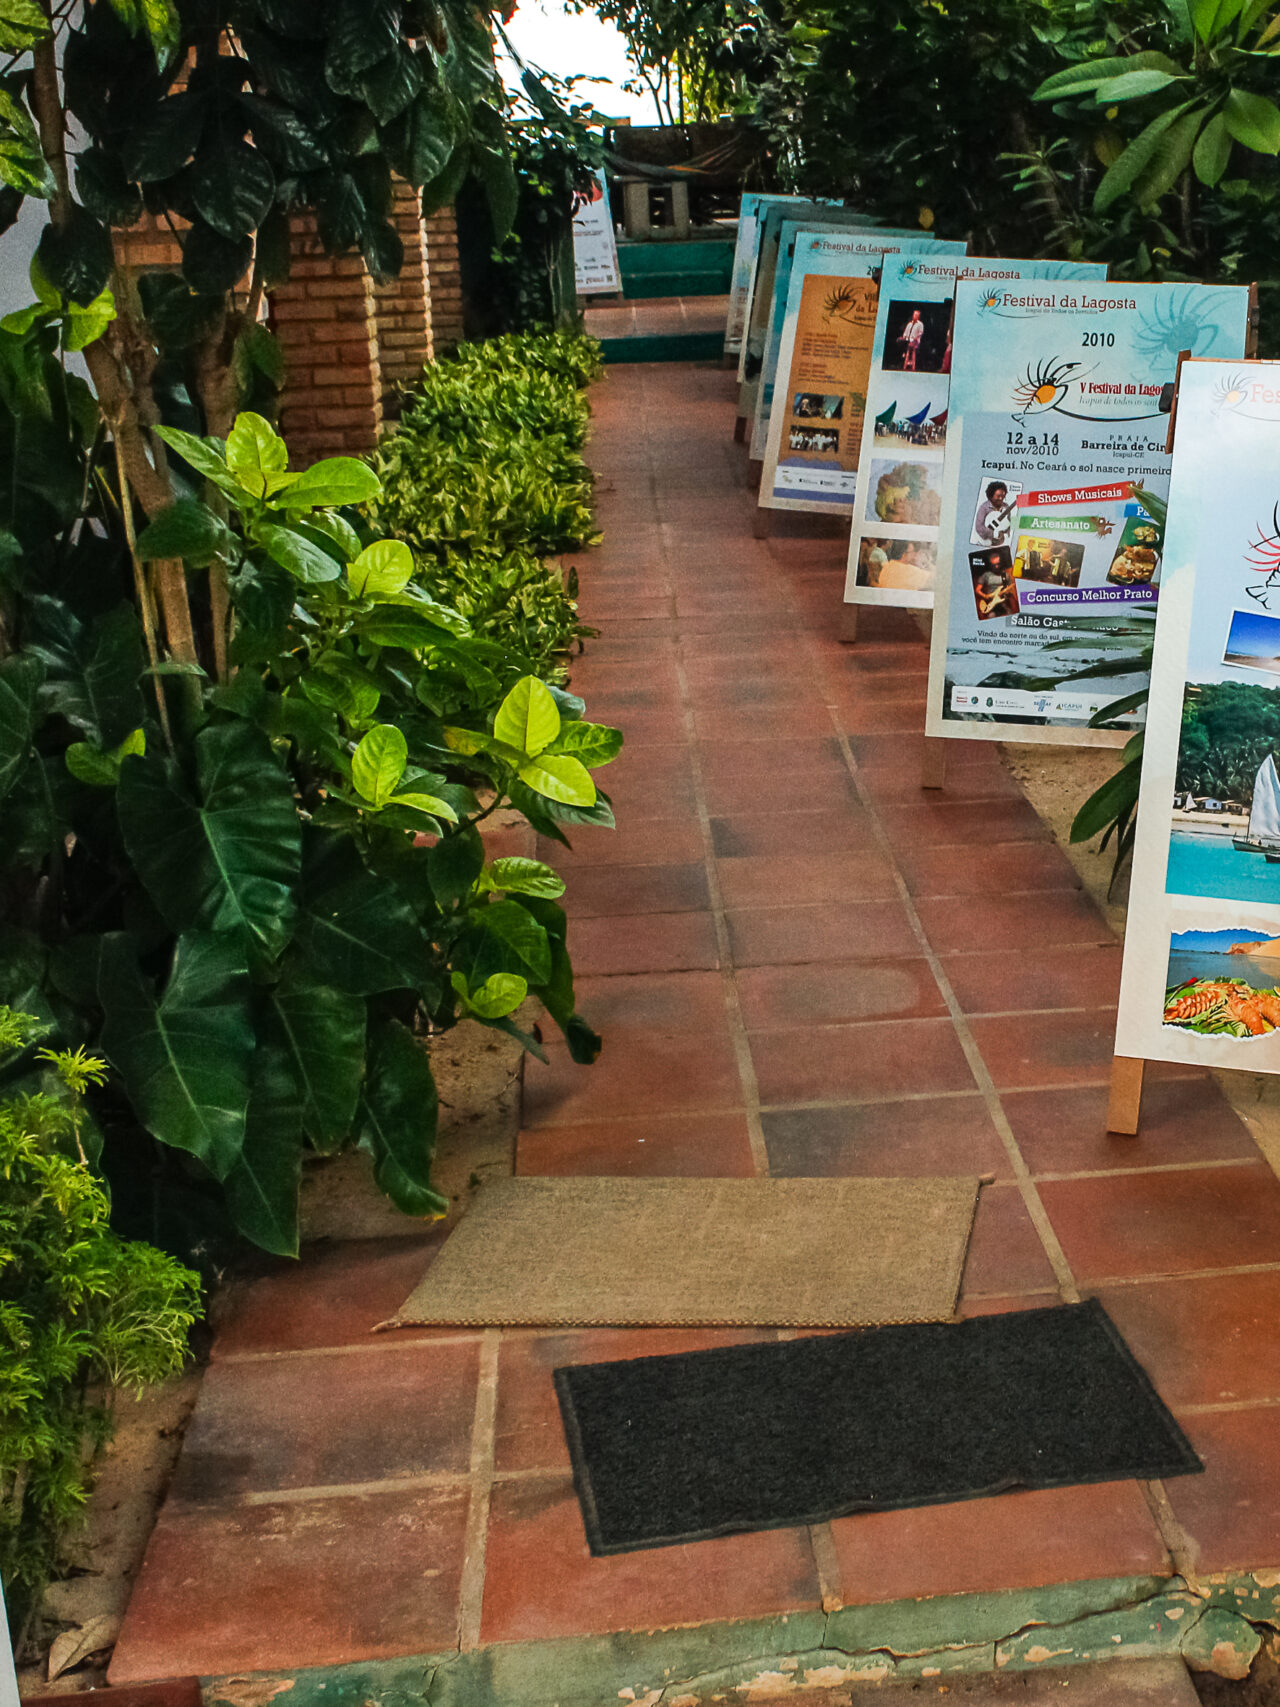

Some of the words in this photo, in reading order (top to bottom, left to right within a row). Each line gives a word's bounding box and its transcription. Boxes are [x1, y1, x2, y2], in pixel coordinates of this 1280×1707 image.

[822, 241, 854, 252] Festival
[918, 264, 958, 276] Festival
[961, 267, 975, 277] da
[978, 268, 1021, 280] Lagosta
[1002, 293, 1056, 308] Festival
[1059, 295, 1077, 308] da
[1081, 295, 1137, 313] Lagosta
[1081, 332, 1116, 347] 2010
[1080, 382, 1087, 394] V
[1088, 382, 1122, 395] Festival
[1124, 384, 1137, 396] da
[1138, 383, 1166, 397] Lago
[1007, 432, 1024, 446] 12
[1028, 434, 1037, 446] a
[1043, 433, 1060, 446] 14
[1081, 440, 1128, 450] Barreira
[1130, 442, 1144, 452] de
[1006, 444, 1060, 457] nov/2010
[981, 460, 1018, 472] Icapuí.
[1020, 461, 1034, 470] No
[1037, 461, 1068, 473] Ceará
[1079, 463, 1094, 473] sol
[1096, 466, 1125, 474] nasce
[1127, 466, 1172, 477] primeiro
[1038, 493, 1073, 504] Shows
[1074, 488, 1122, 501] Musicais
[1031, 518, 1090, 531] Artesanato
[1027, 592, 1079, 602] Concurso
[1082, 590, 1121, 600] Melhor
[1124, 589, 1153, 599] Prato
[1011, 615, 1040, 627] Salão
